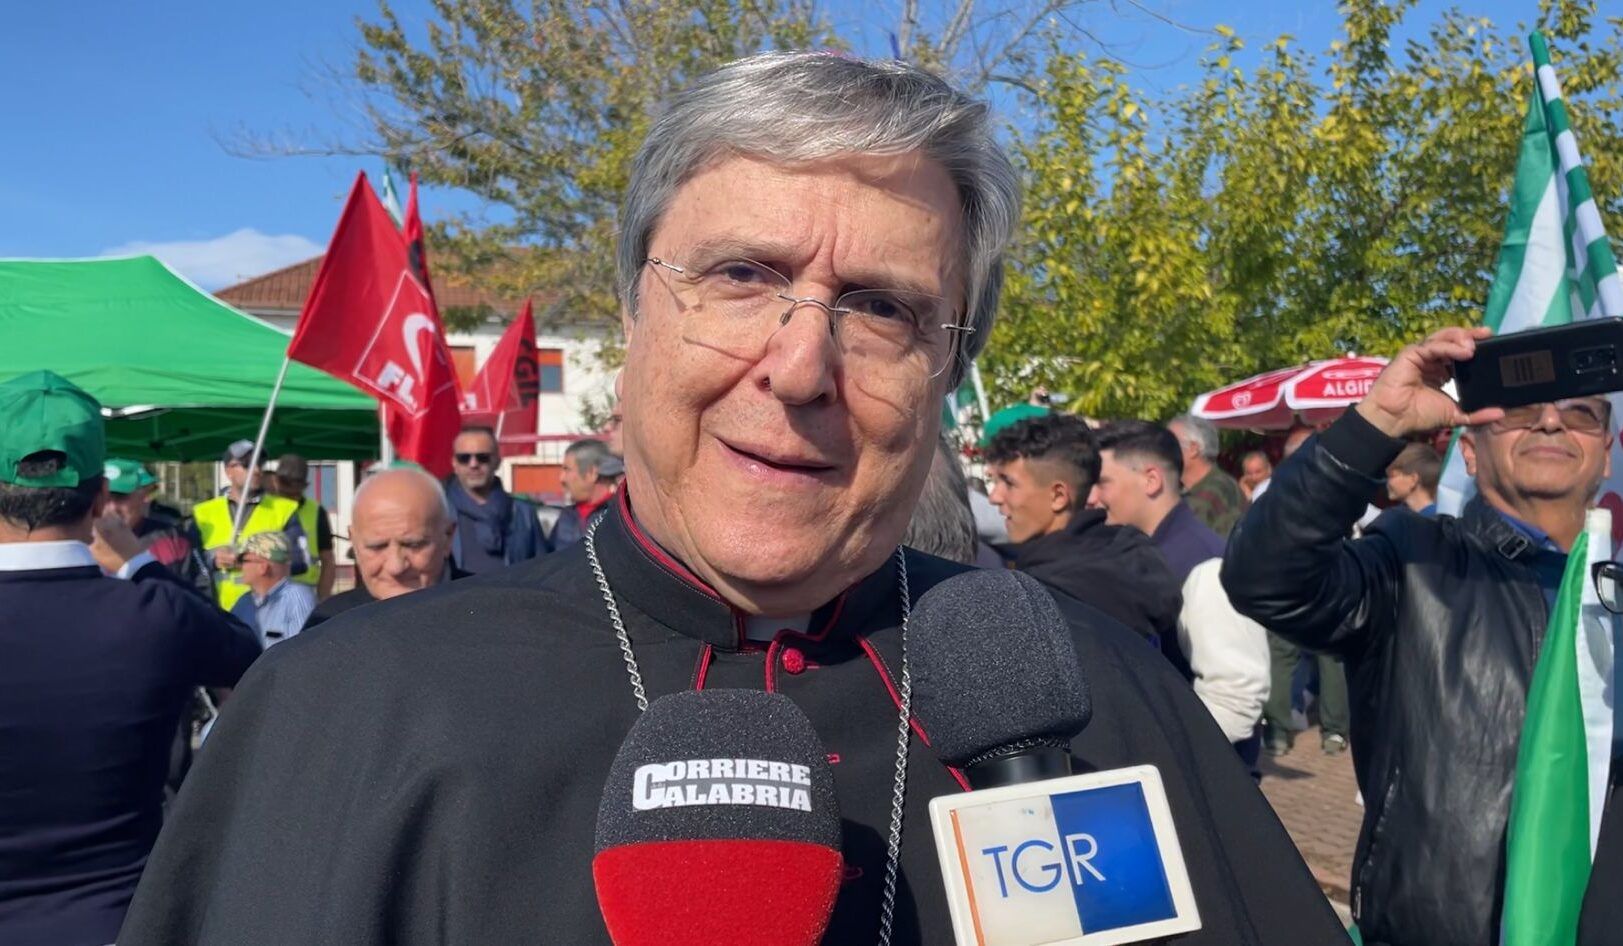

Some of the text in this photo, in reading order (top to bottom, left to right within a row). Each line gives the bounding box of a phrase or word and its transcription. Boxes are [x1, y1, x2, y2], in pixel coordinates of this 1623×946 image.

[377, 359, 418, 411] FL
[633, 759, 812, 786] CORRIERE
[982, 833, 1106, 898] TGR
